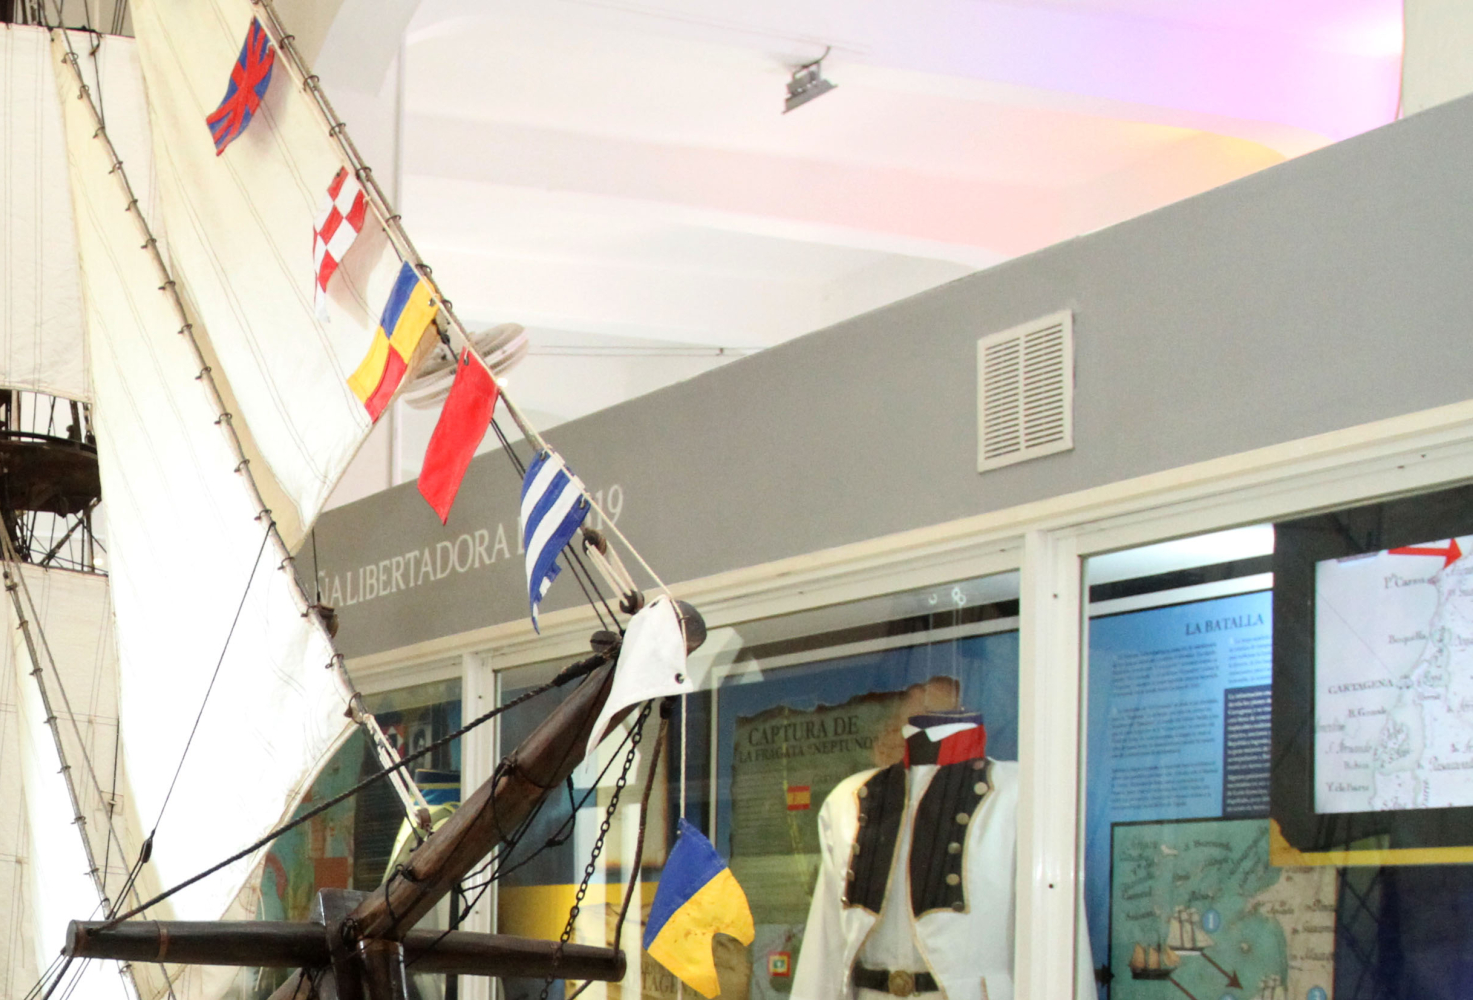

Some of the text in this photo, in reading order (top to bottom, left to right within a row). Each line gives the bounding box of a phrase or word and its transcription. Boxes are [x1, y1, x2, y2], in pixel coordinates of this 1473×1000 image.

[1186, 613, 1264, 636] LA BATALLA
[748, 714, 859, 747] CAPTURA DE
[755, 745, 805, 761] FRAGATA
